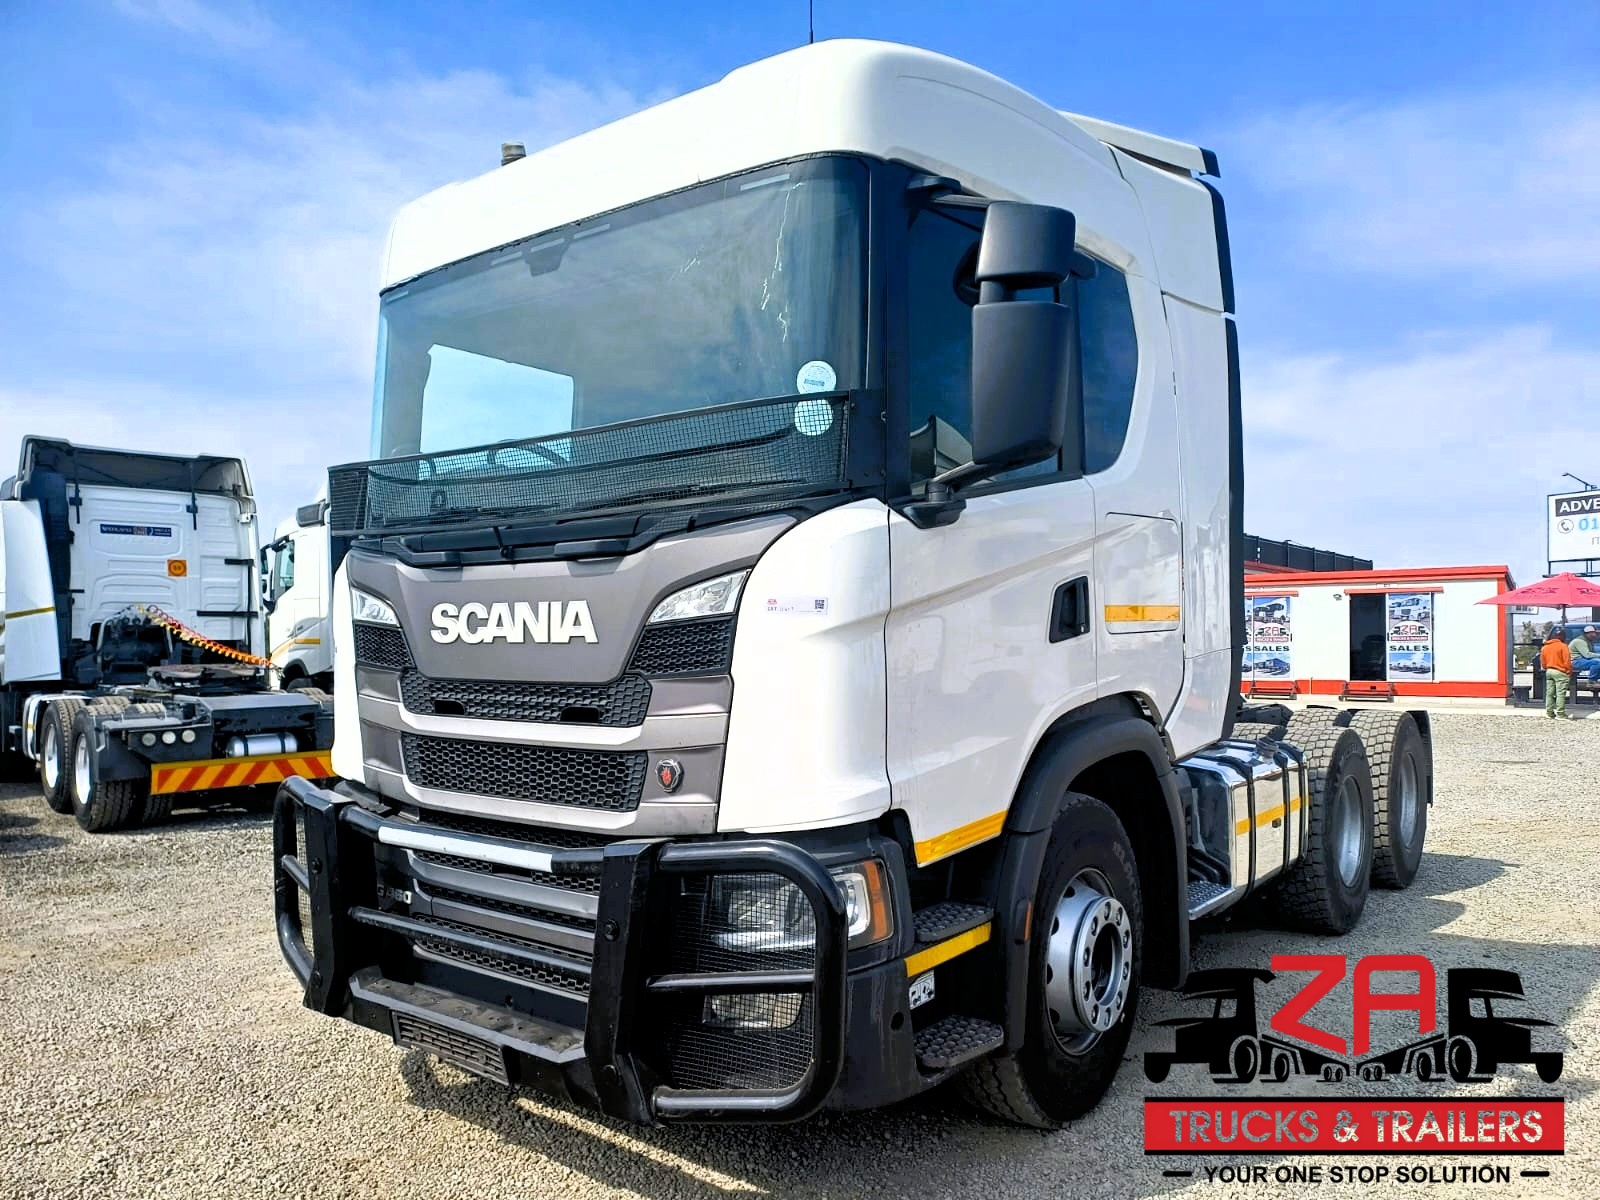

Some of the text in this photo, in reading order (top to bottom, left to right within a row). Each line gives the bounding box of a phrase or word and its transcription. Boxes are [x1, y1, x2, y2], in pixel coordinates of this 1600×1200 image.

[1560, 498, 1600, 513] ADVE
[1579, 518, 1599, 531] 01
[430, 600, 599, 644] SCANIA
